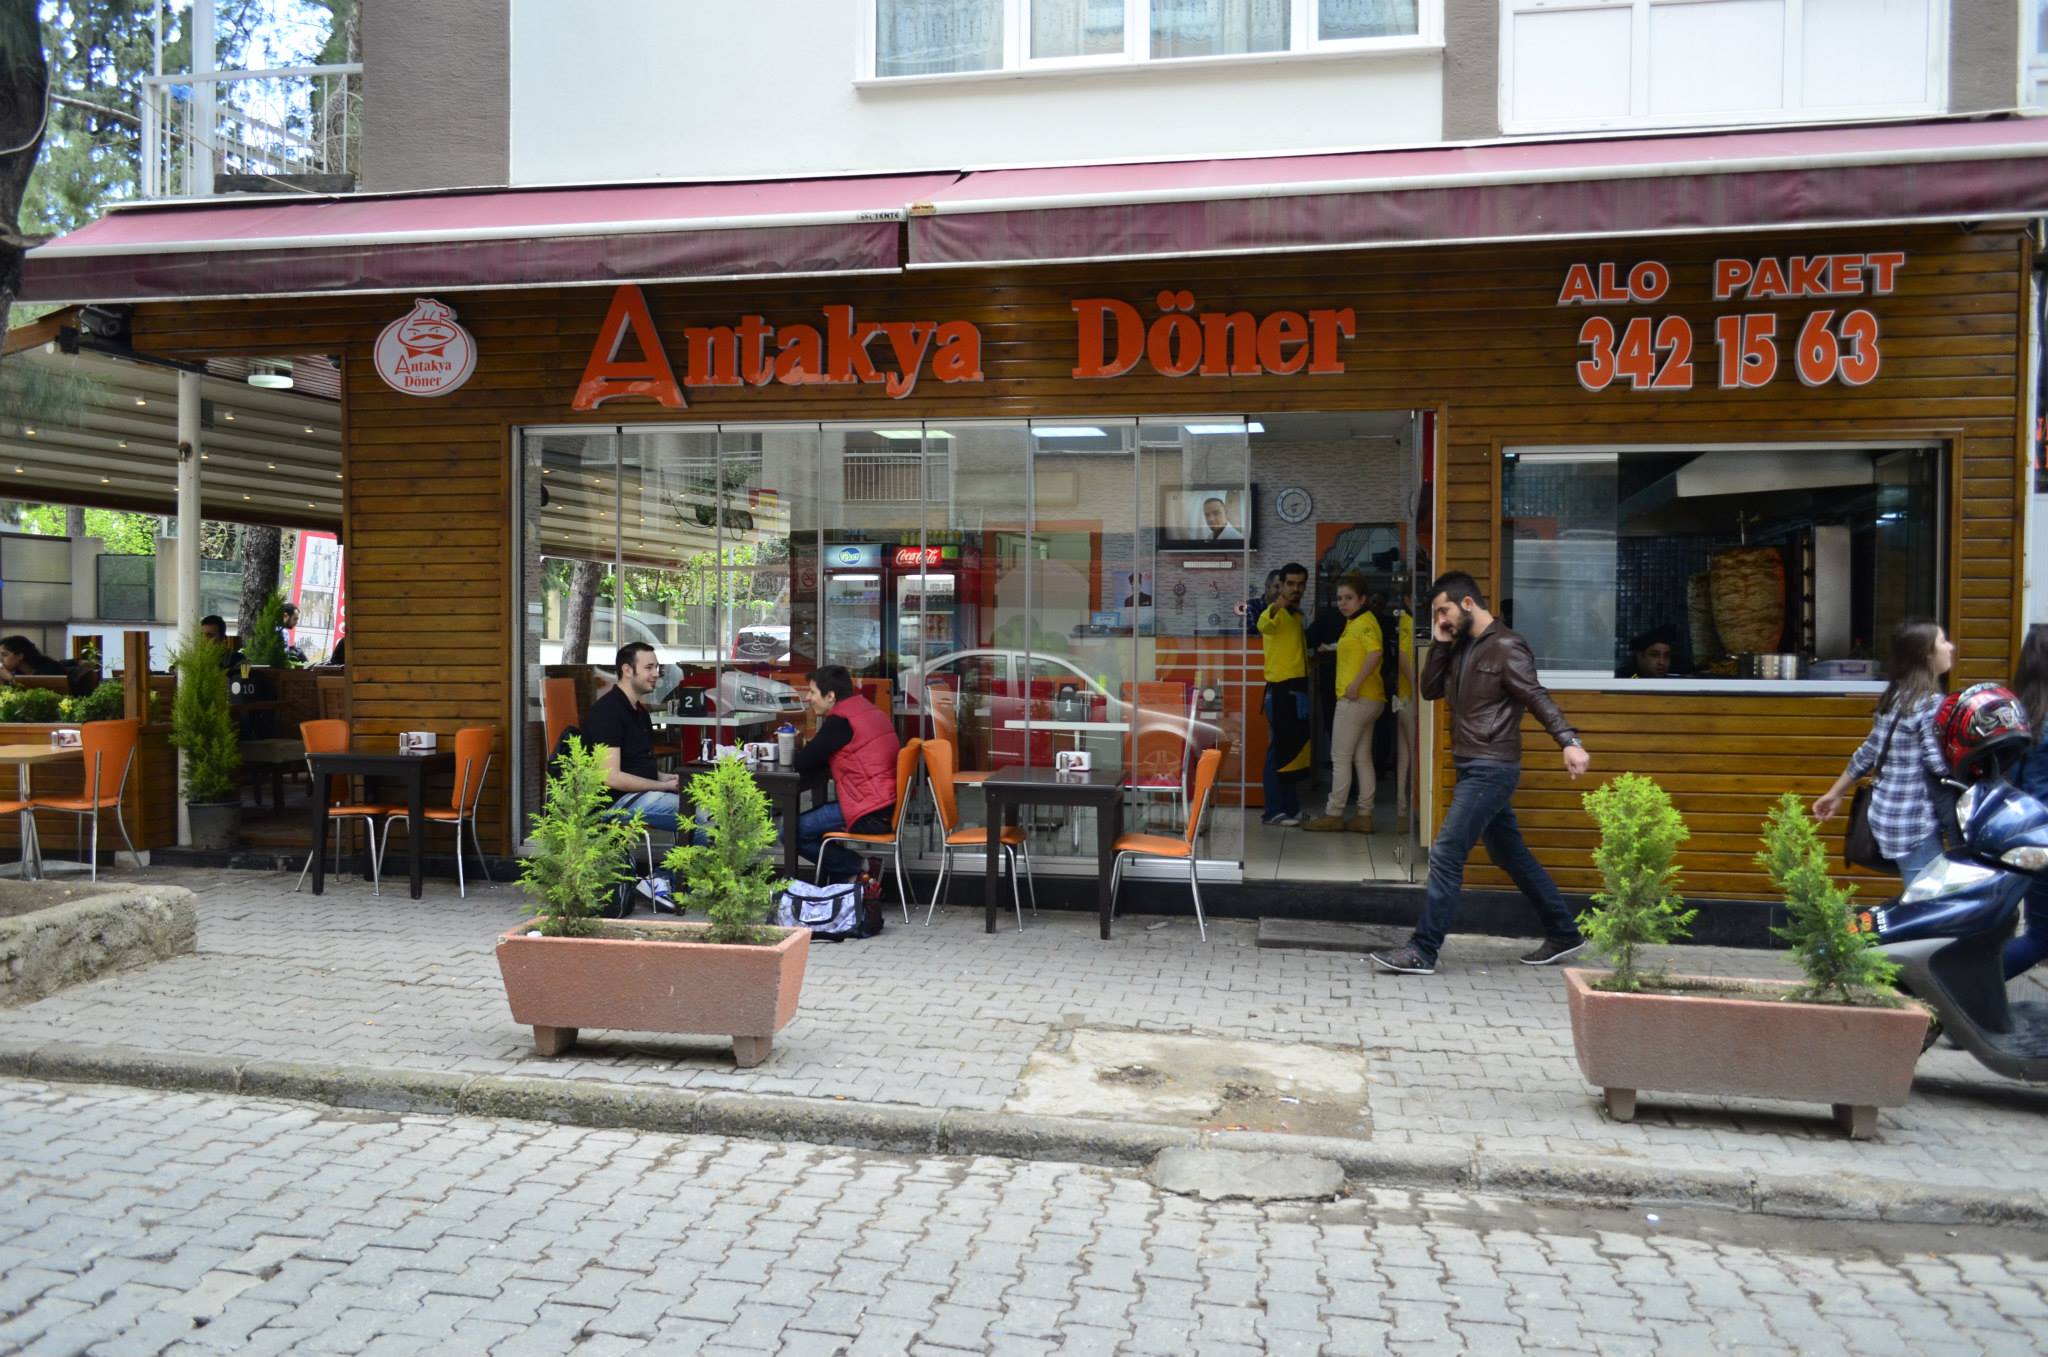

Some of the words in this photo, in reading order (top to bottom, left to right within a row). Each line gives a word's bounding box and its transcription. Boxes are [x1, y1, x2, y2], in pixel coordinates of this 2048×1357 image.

[1558, 261, 1669, 304] ALO
[1714, 251, 1905, 301] PAKET
[571, 284, 984, 410] Antakya
[1071, 290, 1356, 379] Döner
[1577, 315, 1693, 392] 342
[1715, 312, 1778, 389] 15
[1796, 309, 1880, 387] 63
[394, 354, 452, 375] Antakya
[404, 374, 442, 387] Döner
[895, 549, 939, 565] Coca-Cla
[243, 683, 255, 695] 10
[685, 695, 694, 708] 2
[1065, 699, 1072, 712] 1
